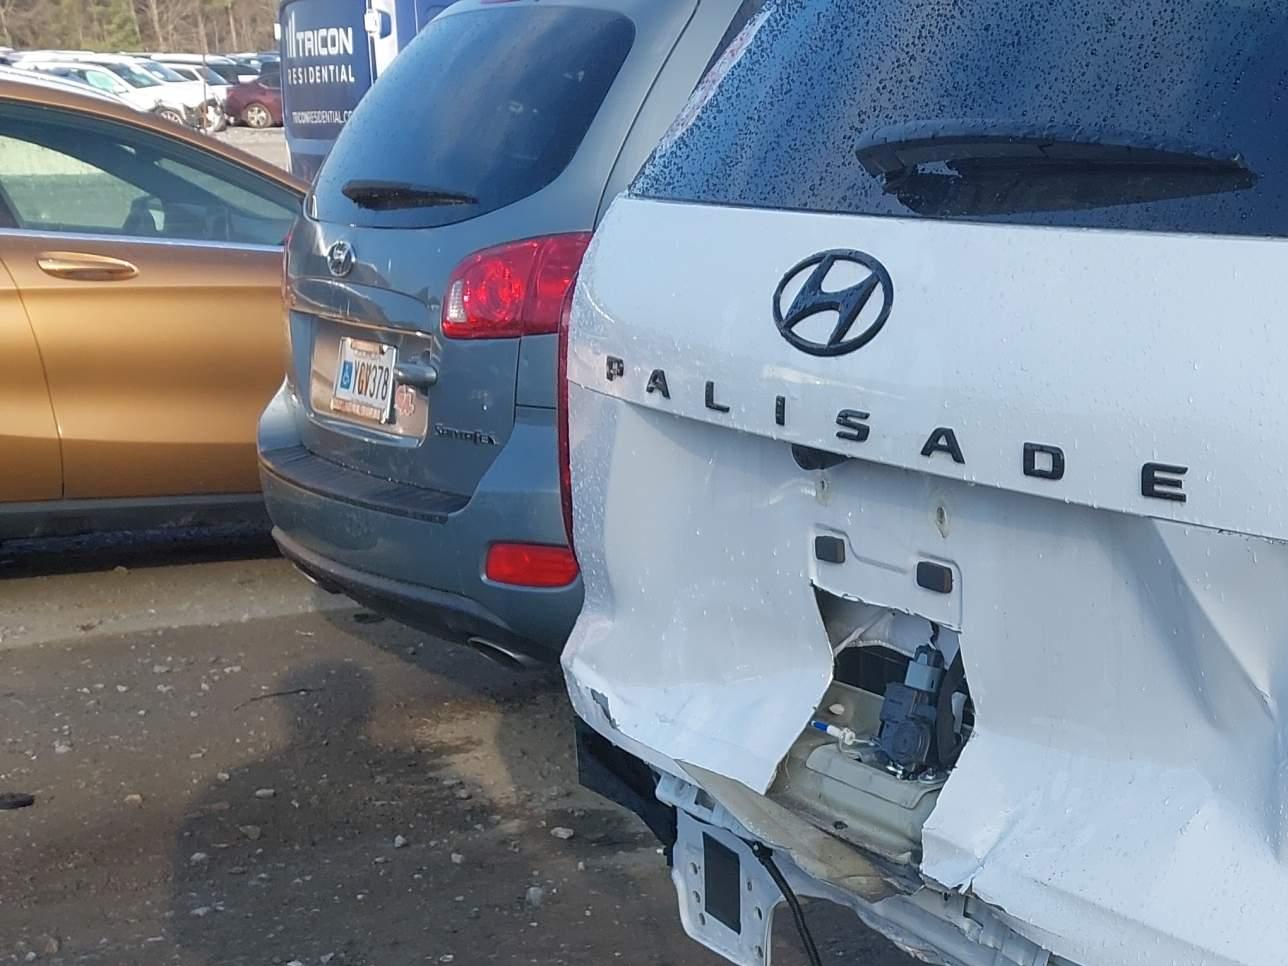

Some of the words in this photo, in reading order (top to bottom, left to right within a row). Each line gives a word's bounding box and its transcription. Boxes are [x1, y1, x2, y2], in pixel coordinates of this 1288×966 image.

[296, 27, 354, 57] TRICON
[287, 64, 355, 85] RESIDENTIAL
[605, 355, 1189, 503] PALISADE
